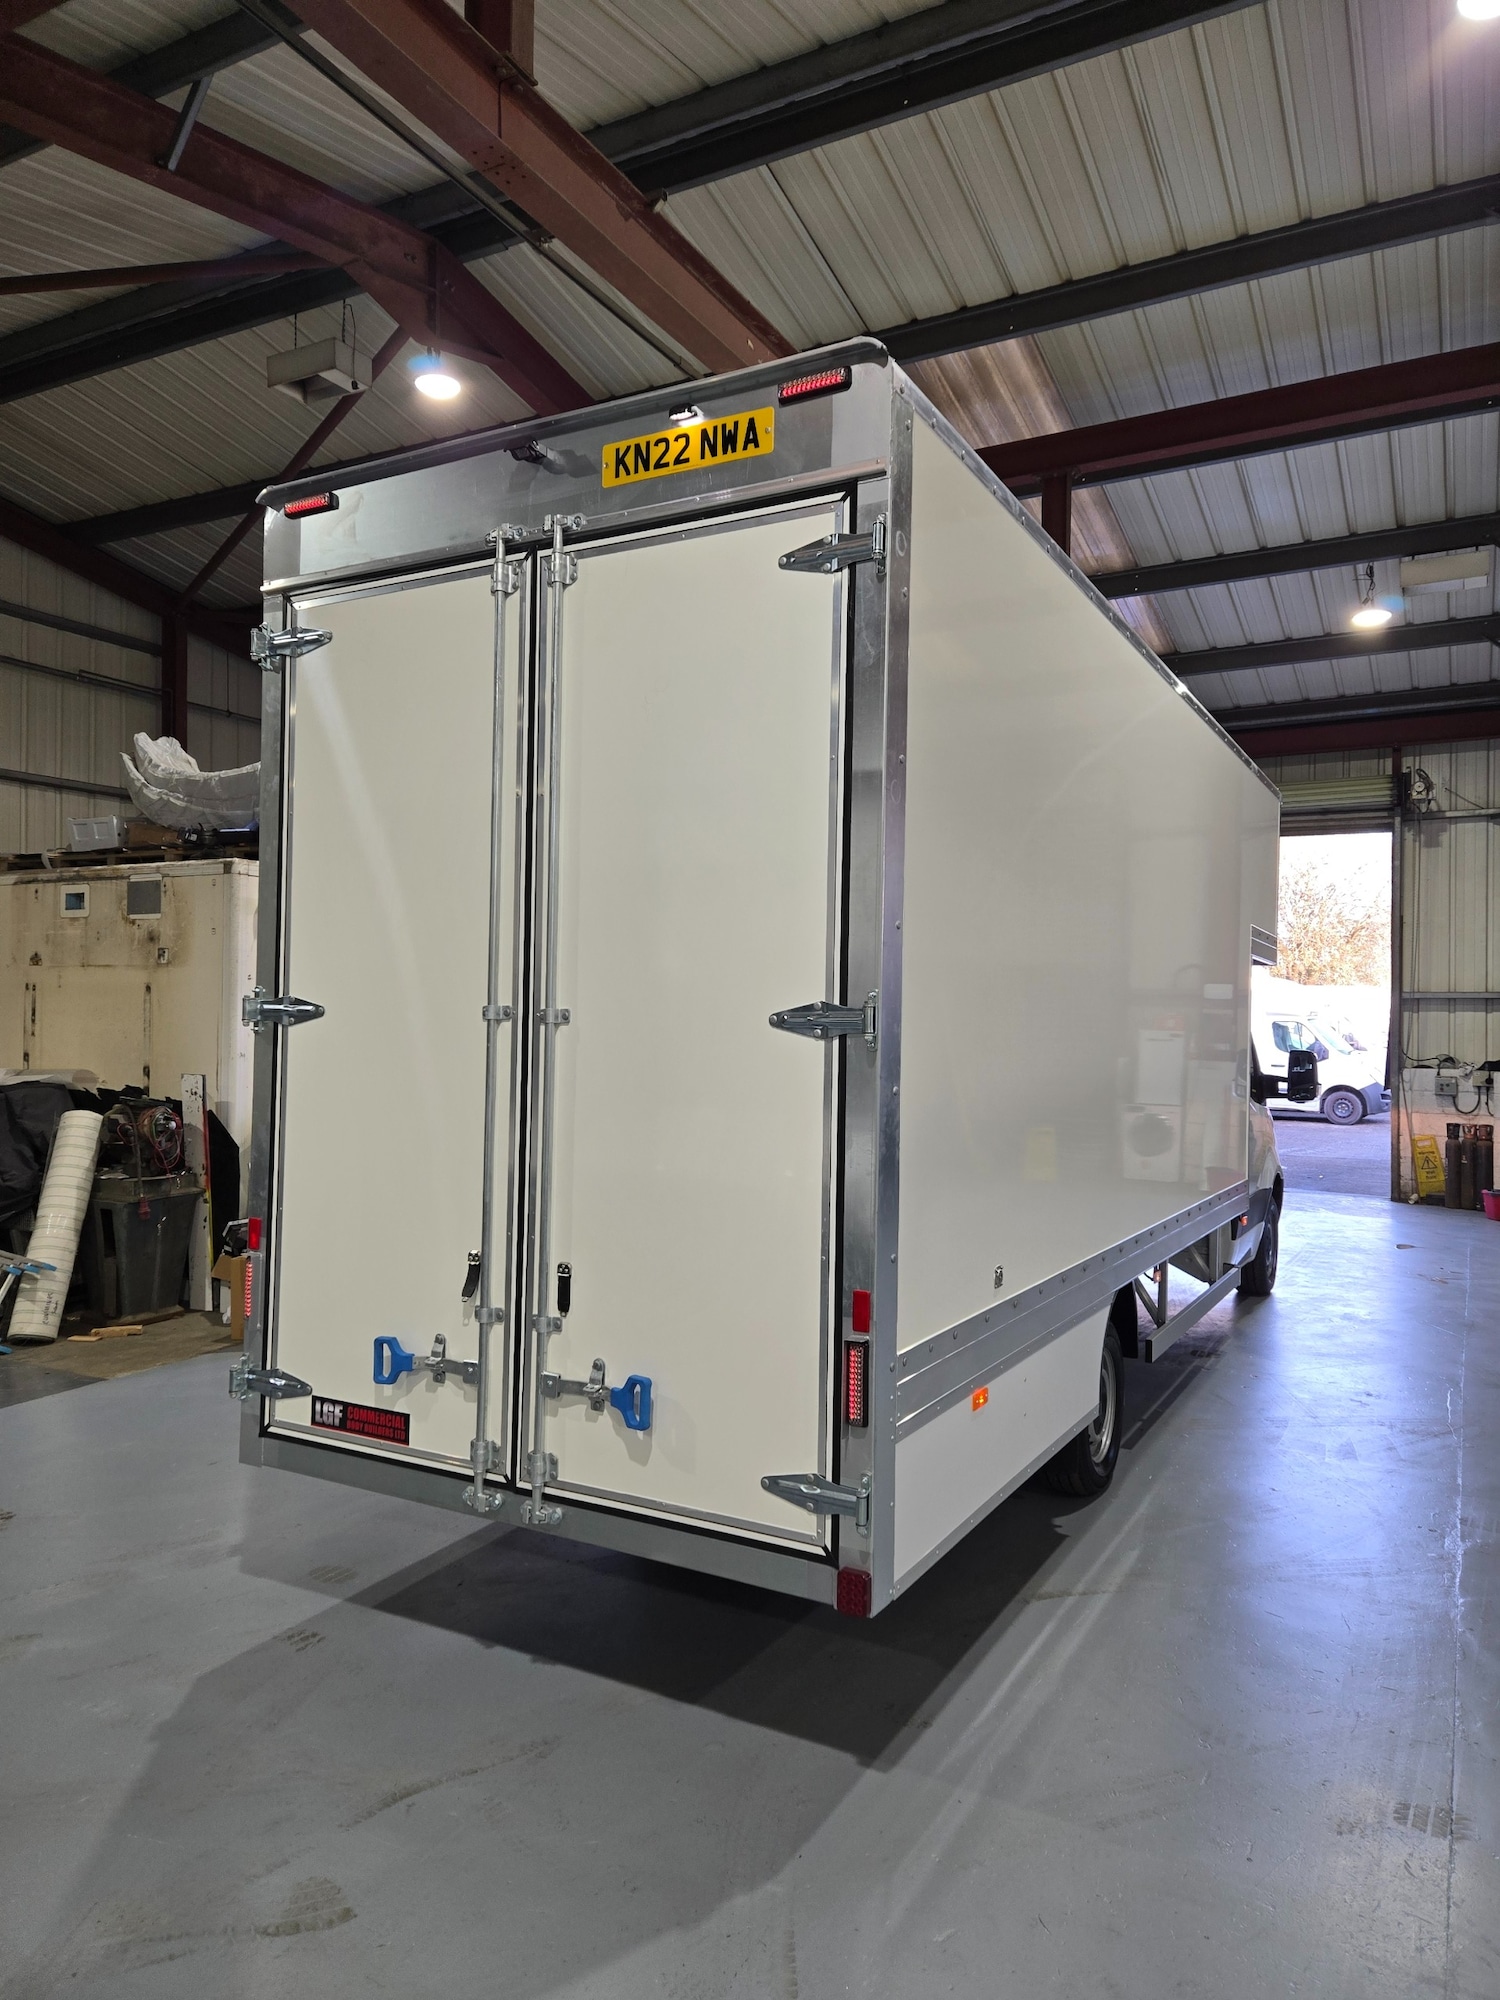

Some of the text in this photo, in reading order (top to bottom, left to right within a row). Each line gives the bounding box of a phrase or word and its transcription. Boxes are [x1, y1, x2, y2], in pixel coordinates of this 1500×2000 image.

[615, 417, 760, 479] KN22 NWA
[315, 1399, 343, 1427] LGF
[347, 1405, 405, 1429] COMMERCIAL
[346, 1420, 405, 1440] BODY BUILDERS LTD
